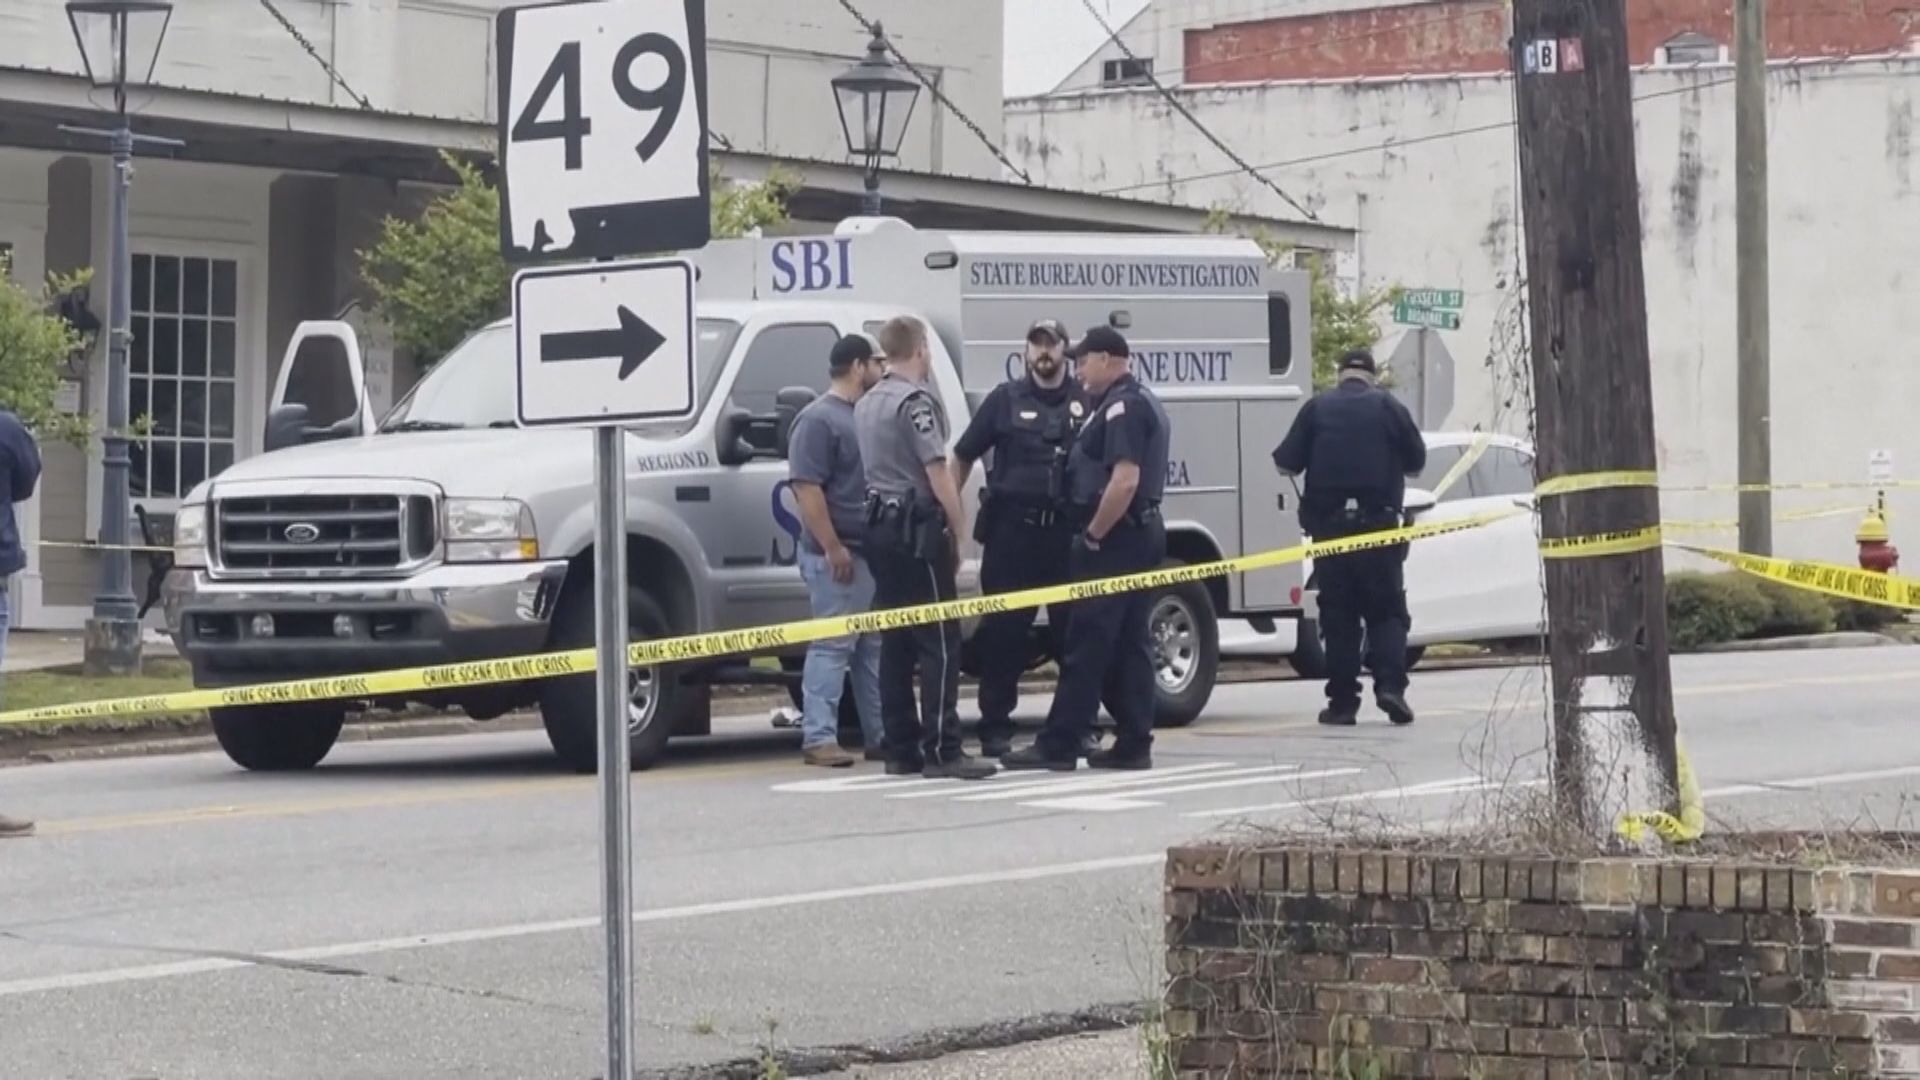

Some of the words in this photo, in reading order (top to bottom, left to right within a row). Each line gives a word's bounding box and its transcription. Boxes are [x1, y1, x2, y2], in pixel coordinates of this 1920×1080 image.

[511, 32, 687, 171] 49
[772, 239, 854, 293] SBI
[971, 262, 1026, 286] STATE
[1029, 262, 1098, 287] BUREAU
[1101, 263, 1125, 287] OF
[1129, 264, 1260, 287] INVESTIGATION
[1173, 351, 1232, 383] UNIT
[638, 452, 697, 472] REGION
[699, 451, 709, 468] D
[1068, 582, 1106, 600] CRIME
[1110, 577, 1149, 594] SCENE
[1863, 575, 1887, 600] CROSS
[846, 614, 881, 633] CRIME
[885, 610, 921, 628] SCENE
[943, 602, 965, 620] NOT
[968, 598, 1008, 616] CROSS
[630, 644, 664, 663] CRIME
[668, 640, 702, 658] SCENE
[724, 633, 745, 651] NOT
[749, 628, 786, 648] CROSS
[423, 669, 456, 687] CRIME
[459, 664, 491, 683] SCENE
[512, 659, 534, 677] NOT
[536, 655, 573, 674] CROSS
[222, 688, 254, 705] CRIME
[258, 685, 290, 701] SCENE
[310, 681, 330, 696] NOT
[332, 677, 369, 694] CROSS
